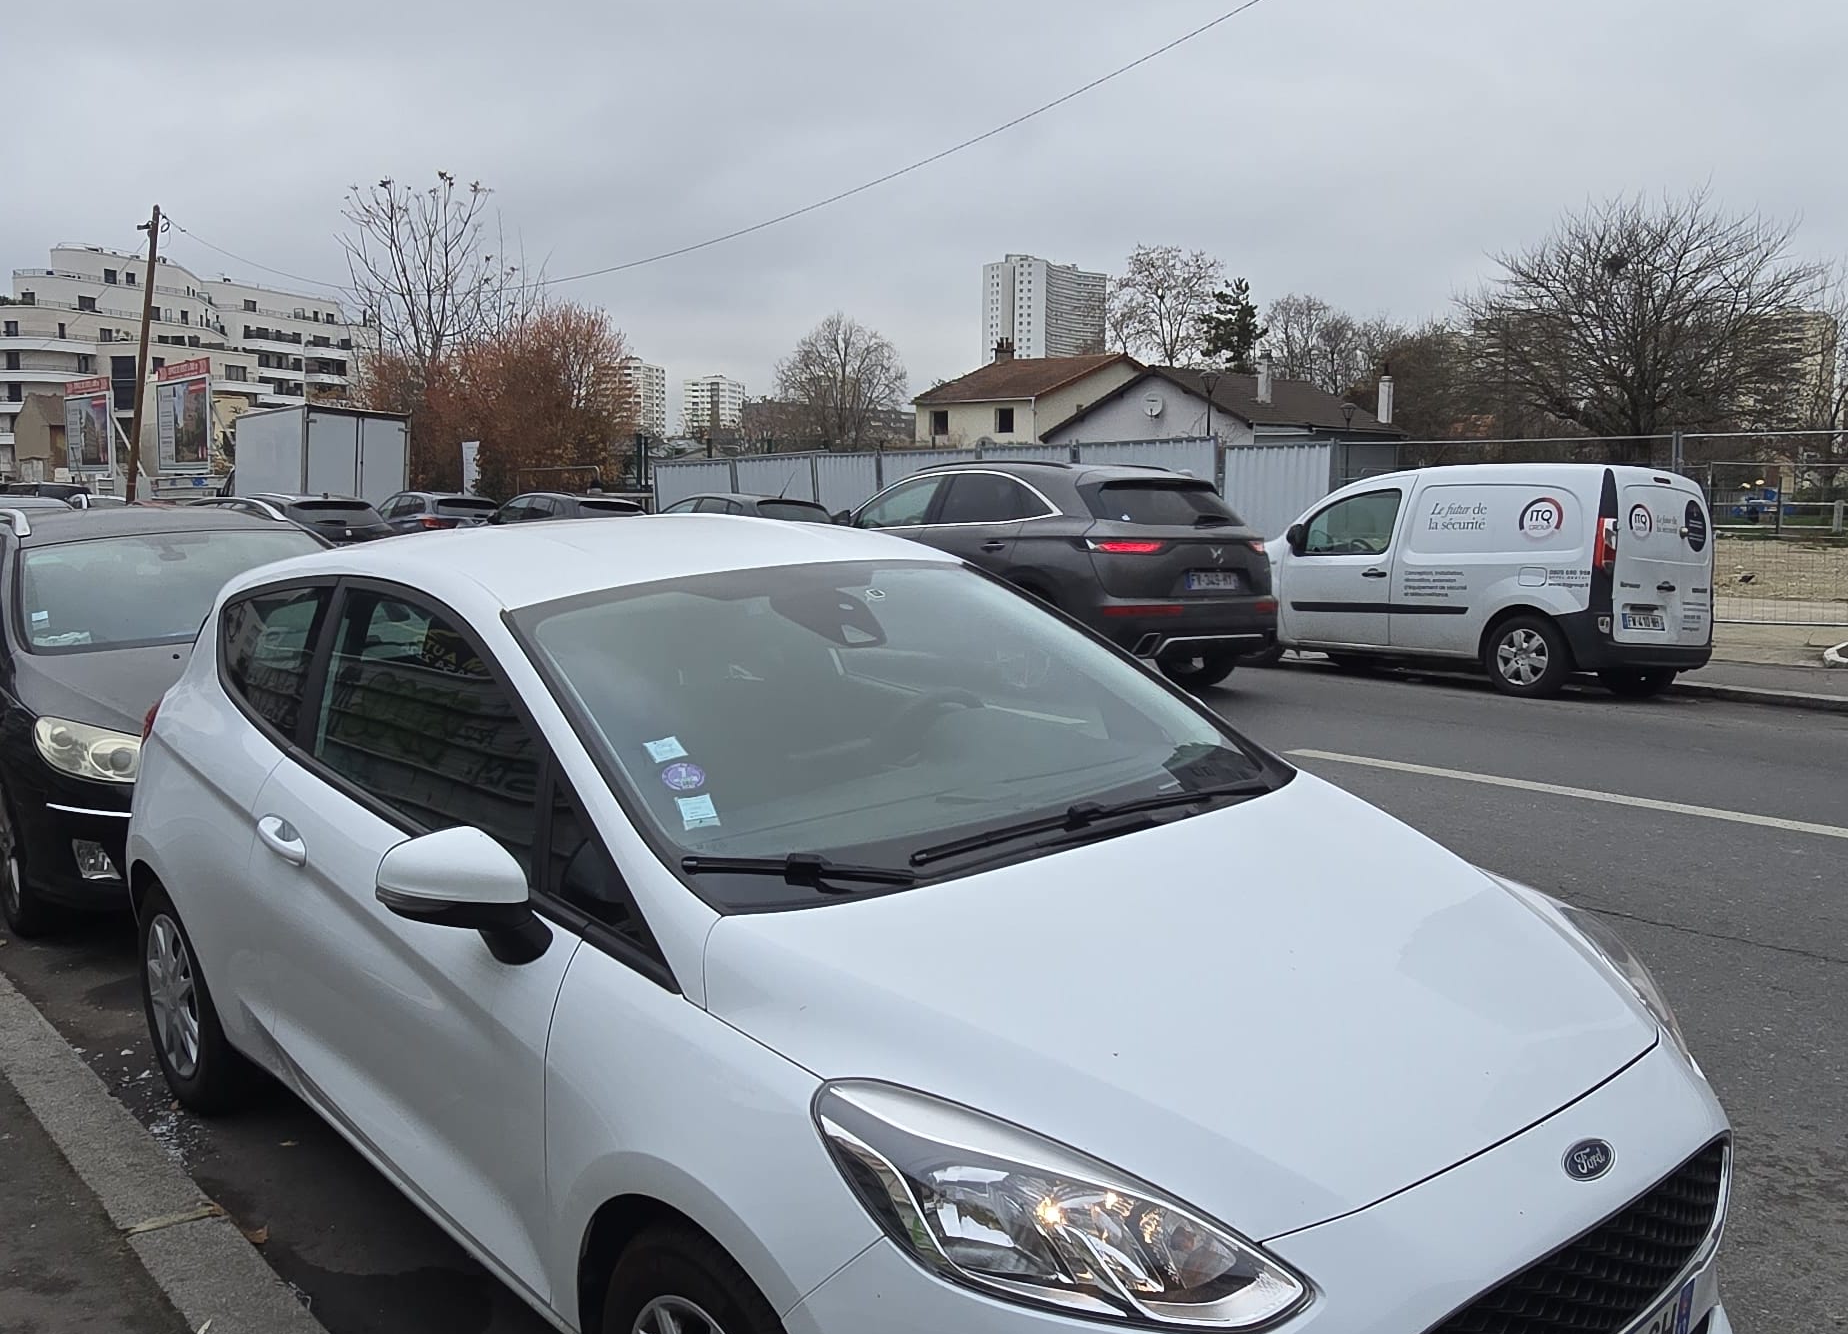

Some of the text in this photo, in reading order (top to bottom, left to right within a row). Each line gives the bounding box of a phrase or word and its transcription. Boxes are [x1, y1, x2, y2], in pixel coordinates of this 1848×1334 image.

[1430, 502, 1487, 518] Le futur de
[1529, 509, 1553, 524] ITQ
[1428, 517, 1486, 530] la sécurité
[1634, 513, 1647, 526] ITQ
[1574, 1146, 1606, 1174] Ford
